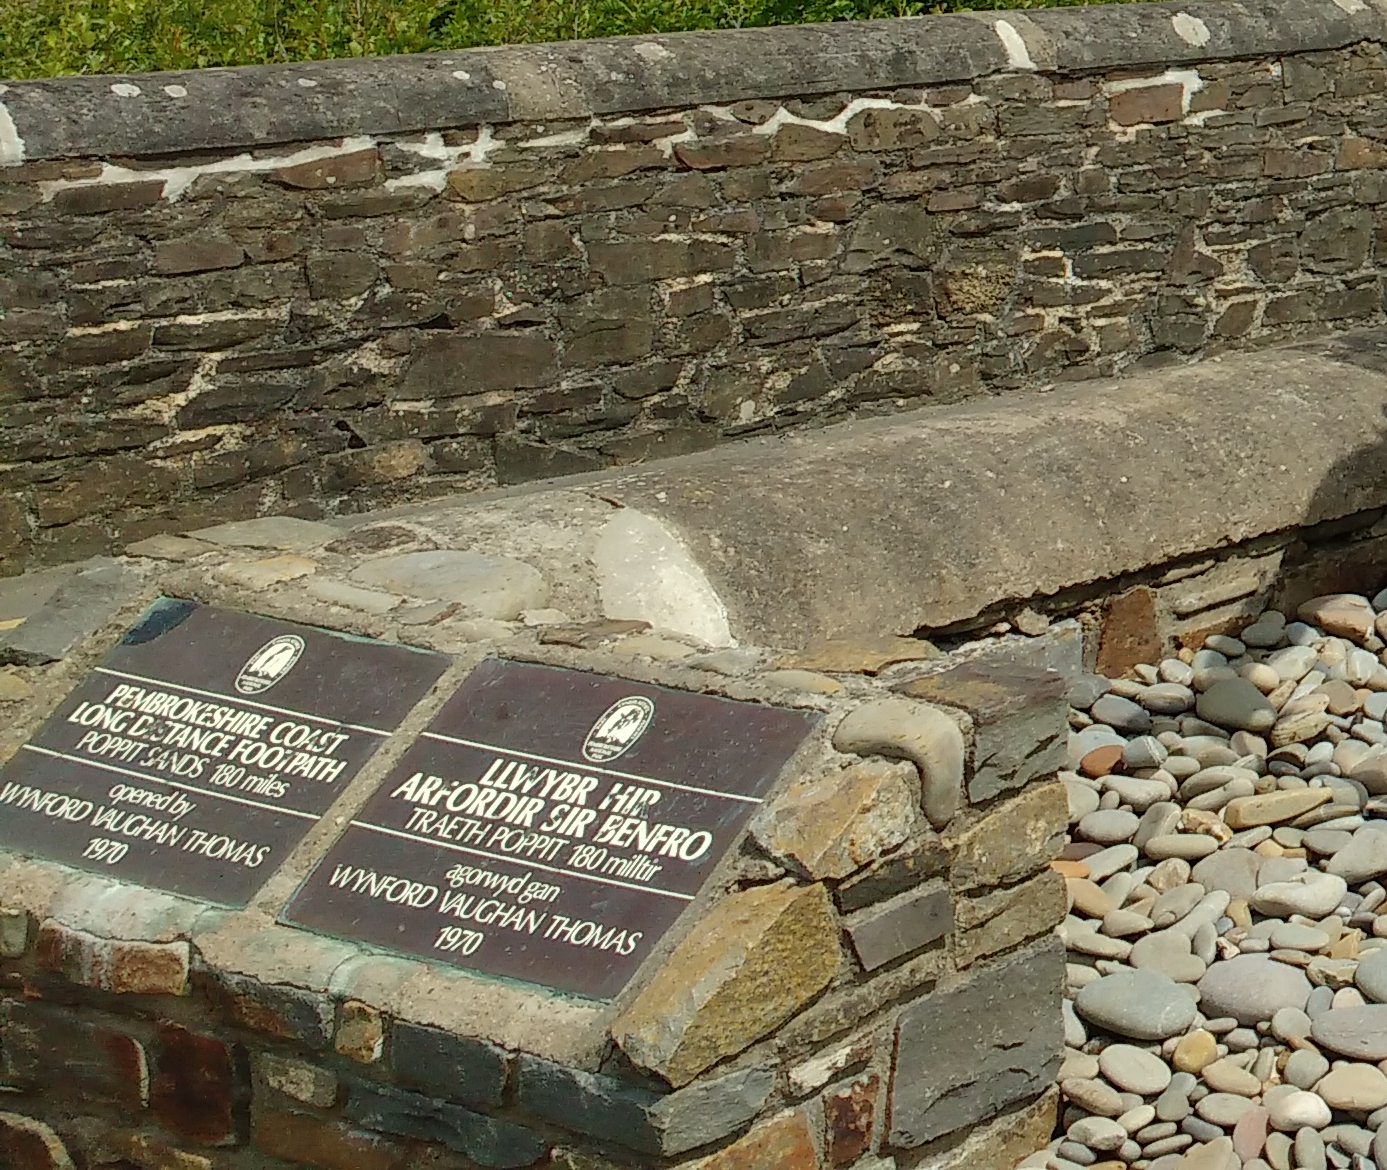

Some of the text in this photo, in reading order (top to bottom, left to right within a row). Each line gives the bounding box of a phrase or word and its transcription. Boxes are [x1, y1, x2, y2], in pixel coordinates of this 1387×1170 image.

[67, 701, 348, 783] LONG DSTANCE FOOTPATH
[104, 684, 350, 756] PEMBROKESHIRE COAST
[75, 730, 291, 798] POPPIT SANDS 180 miles
[478, 758, 663, 819] LLWYBR HIR
[0, 782, 271, 868] WYNFORD VAUGHAN THOMAS
[108, 783, 198, 821] opened by
[389, 772, 713, 861] ARFORDIR SIR BENFRO
[82, 837, 130, 864] 1970
[404, 807, 663, 882] TRAETH POPPIT 180 milltir
[328, 865, 644, 956] WYNFORD VAUGHAN THOMAS
[445, 863, 561, 903] agorwyd gan
[433, 926, 484, 956] 1970
